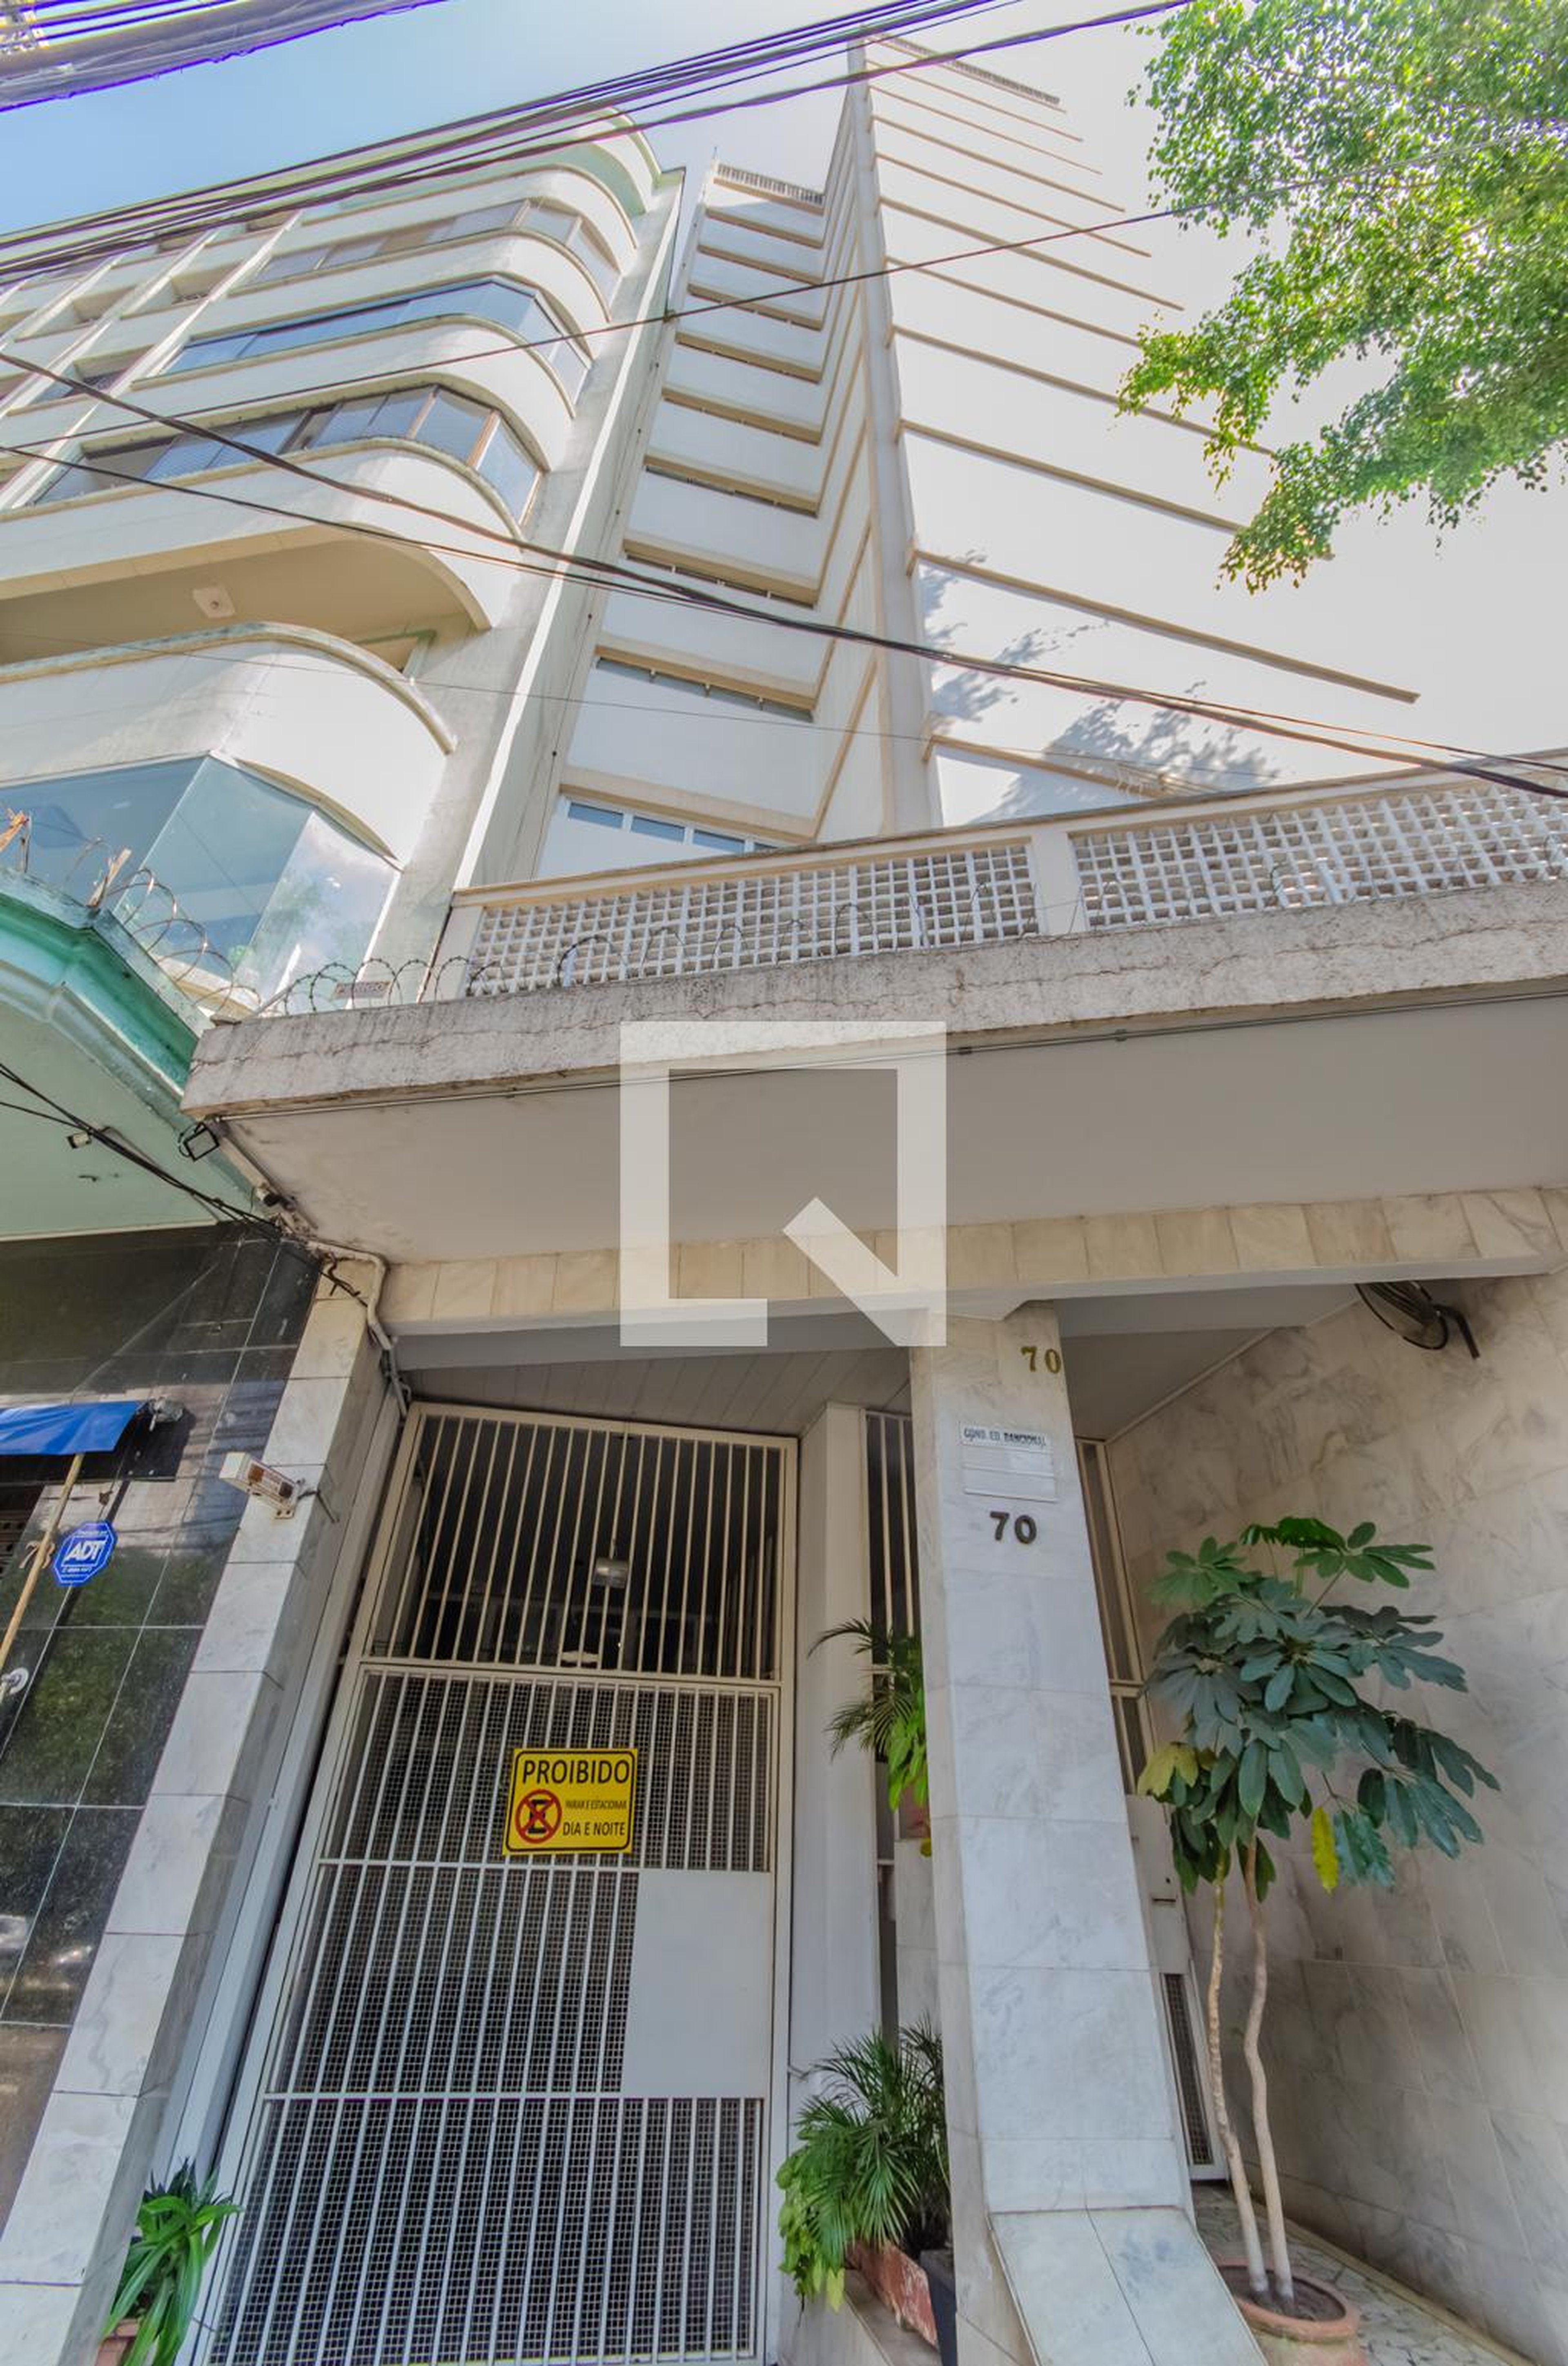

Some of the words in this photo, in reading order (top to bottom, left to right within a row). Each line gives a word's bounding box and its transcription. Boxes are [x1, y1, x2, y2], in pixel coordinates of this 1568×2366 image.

[1021, 1346, 1062, 1374] 70
[990, 1511, 1037, 1544] 70
[63, 1540, 107, 1561] ADT
[522, 1759, 630, 1784] PROIBIDO
[563, 1822, 581, 1836] DIA
[584, 1822, 590, 1835] E
[593, 1822, 625, 1836] NOITE
